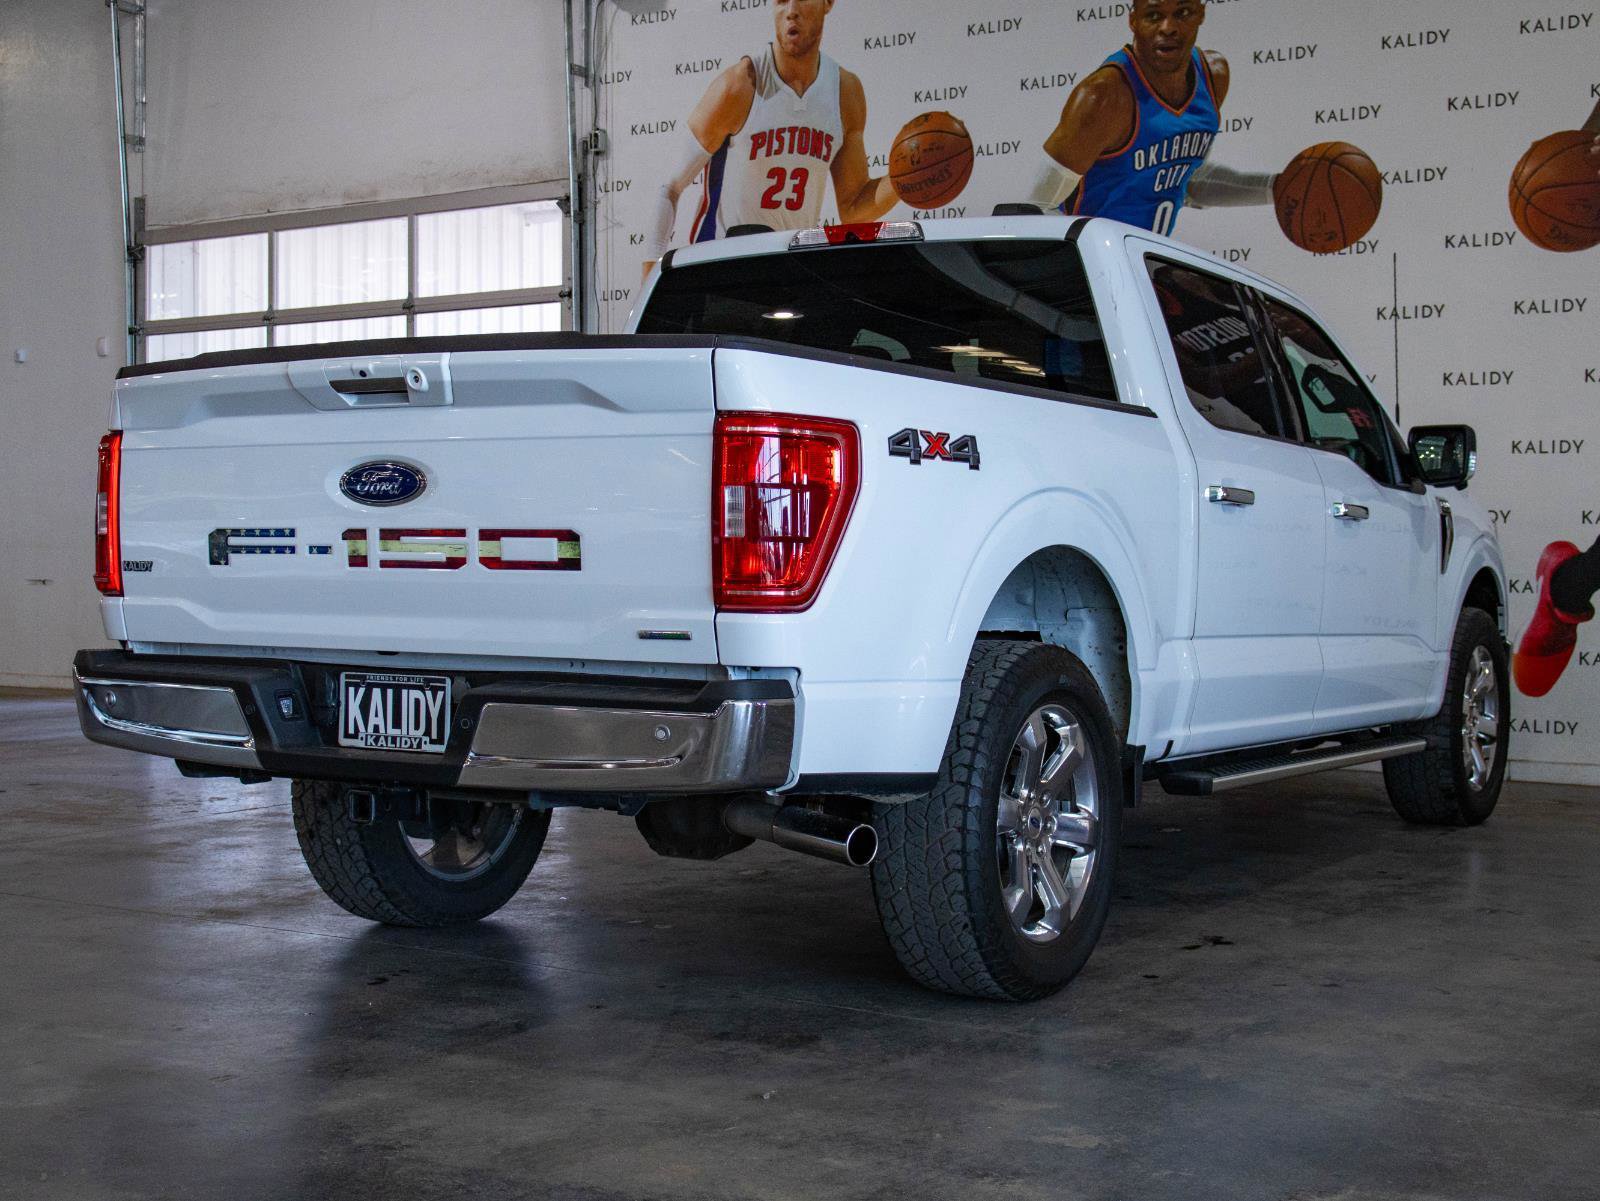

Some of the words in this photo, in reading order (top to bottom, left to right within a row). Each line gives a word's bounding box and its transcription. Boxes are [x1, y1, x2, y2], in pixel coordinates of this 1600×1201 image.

[631, 9, 677, 26] KALIDY
[1076, 4, 1134, 22] KALIDY
[967, 17, 1022, 37] KALIDY
[1520, 13, 1593, 35] KALIDY
[864, 32, 916, 50] KALIDY
[1381, 29, 1450, 50] KALIDY
[1253, 44, 1317, 64] KALIDY
[675, 58, 722, 75] KALIDY
[600, 70, 632, 85] LIDY
[1020, 73, 1077, 91] KALIDY
[914, 86, 968, 103] KALIDY
[1448, 91, 1519, 112] KALIDY
[1315, 104, 1381, 124] KALIDY
[631, 120, 677, 136] KALIDY
[1217, 117, 1254, 133] IDY
[750, 126, 834, 163] PISTONS
[976, 141, 1021, 157] ALIDY
[1134, 132, 1212, 170] OKLAHOM
[1154, 164, 1190, 192] CITY
[1380, 166, 1448, 185] KALIDY
[599, 180, 632, 193] LIDY
[760, 167, 809, 211] 23
[1445, 231, 1516, 249] KALIDY
[602, 290, 630, 301] LIDY
[1377, 304, 1445, 320] KALIDY
[1514, 298, 1587, 315] KALIDY
[1443, 371, 1514, 386] KALIDY
[1511, 440, 1585, 455] KALIDY
[357, 469, 403, 493] Ford
[208, 528, 581, 571] F-150
[122, 560, 153, 573] KALIDY
[348, 686, 444, 739] KALIDY
[367, 735, 420, 749] KALIDY
